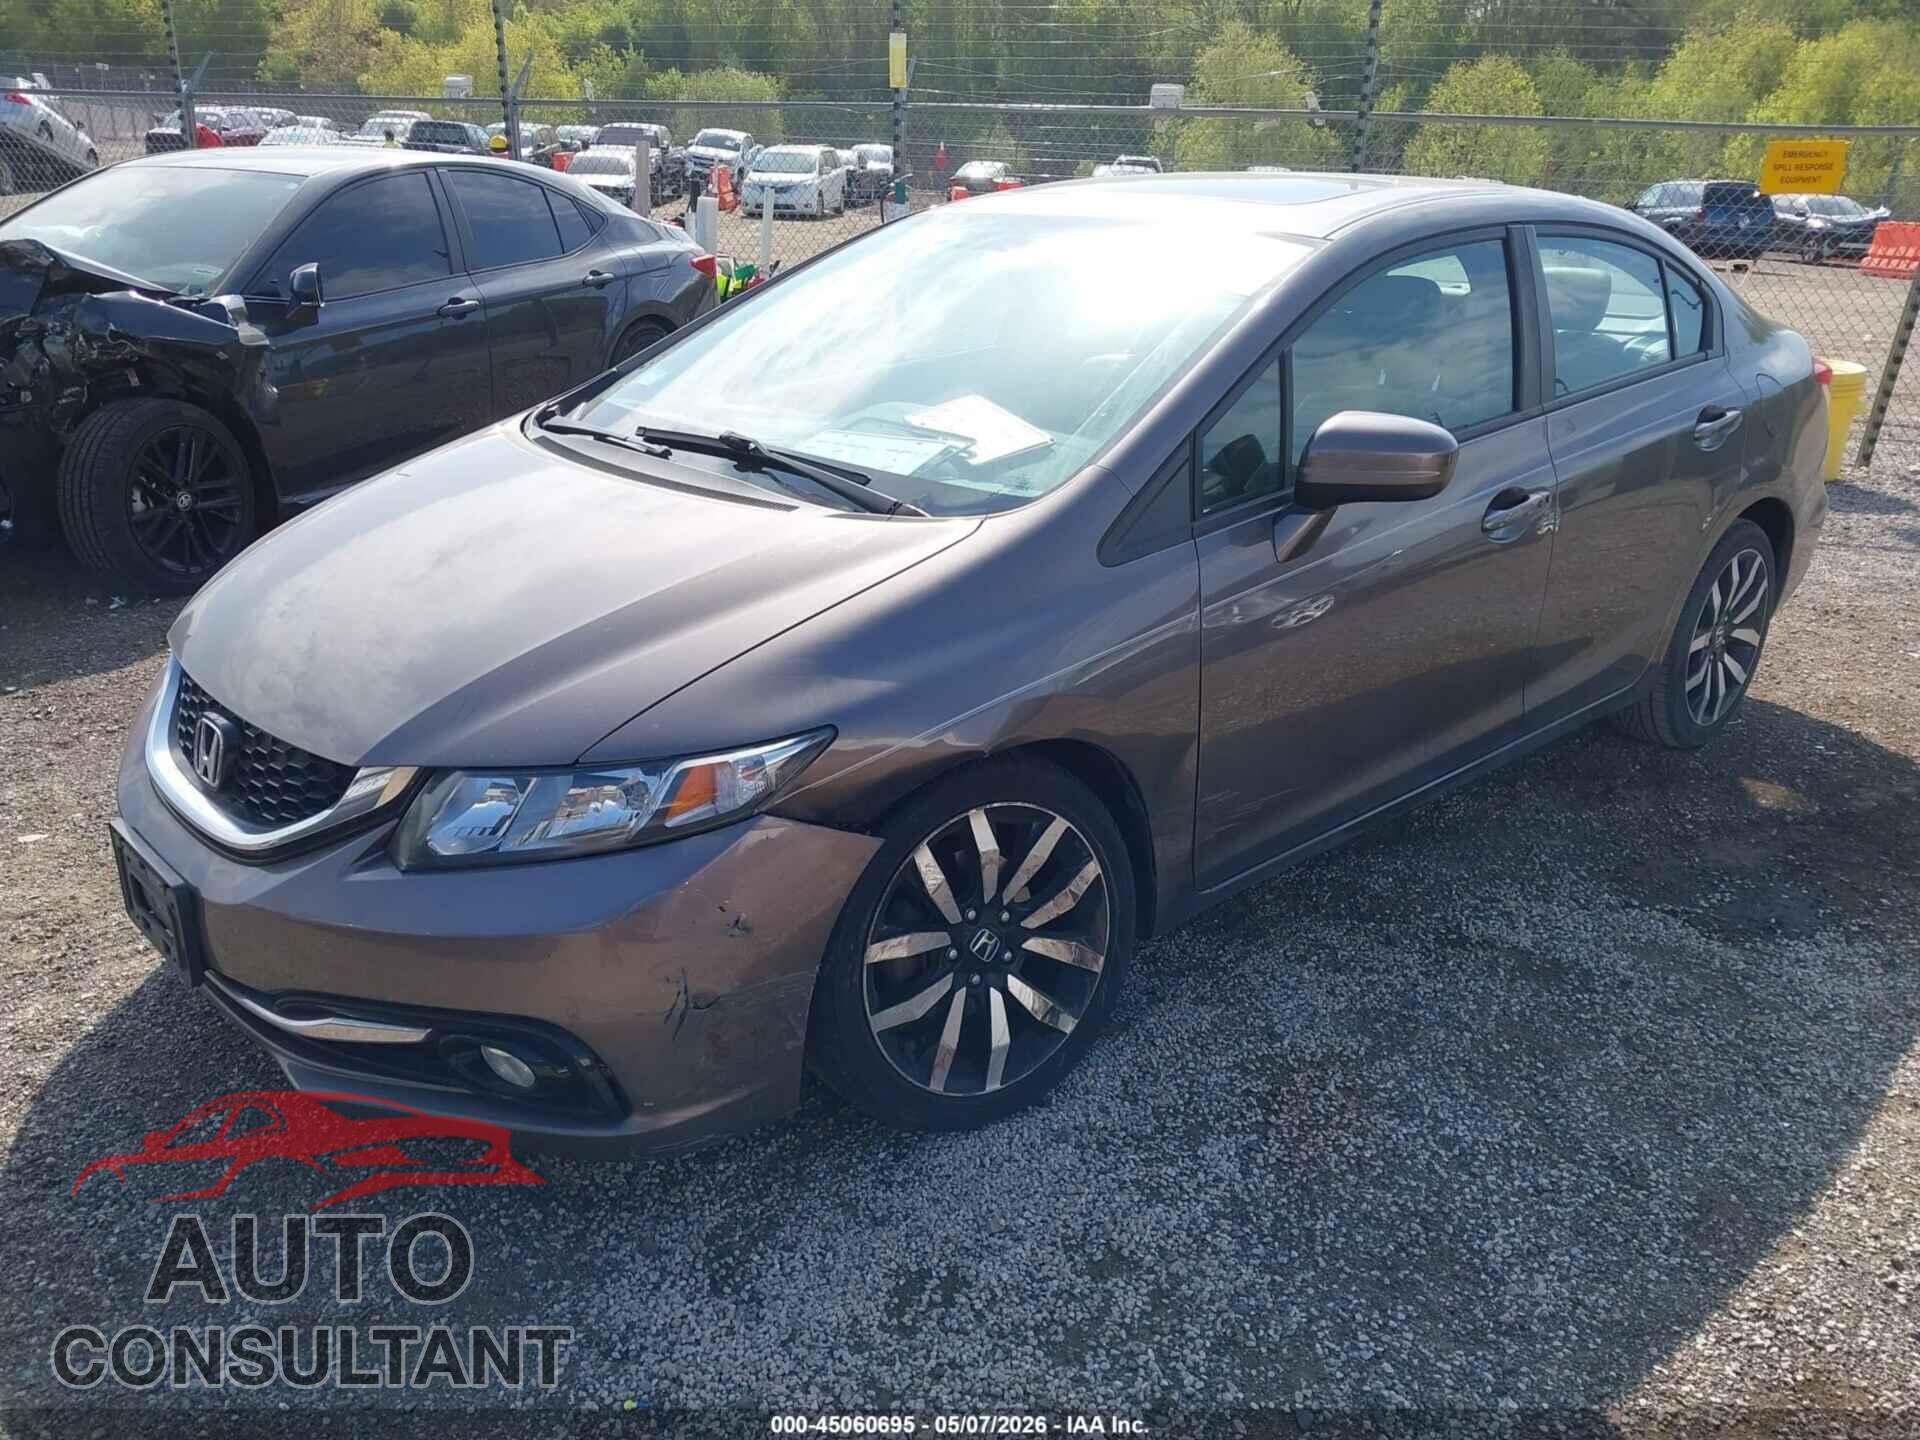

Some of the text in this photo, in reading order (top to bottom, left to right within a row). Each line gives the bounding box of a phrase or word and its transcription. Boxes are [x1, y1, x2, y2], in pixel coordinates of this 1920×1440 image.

[1782, 150, 1828, 158] EMERGENCY
[1774, 162, 1833, 171] SPILL RESPONSE
[1780, 176, 1822, 184] EQUIPMENT
